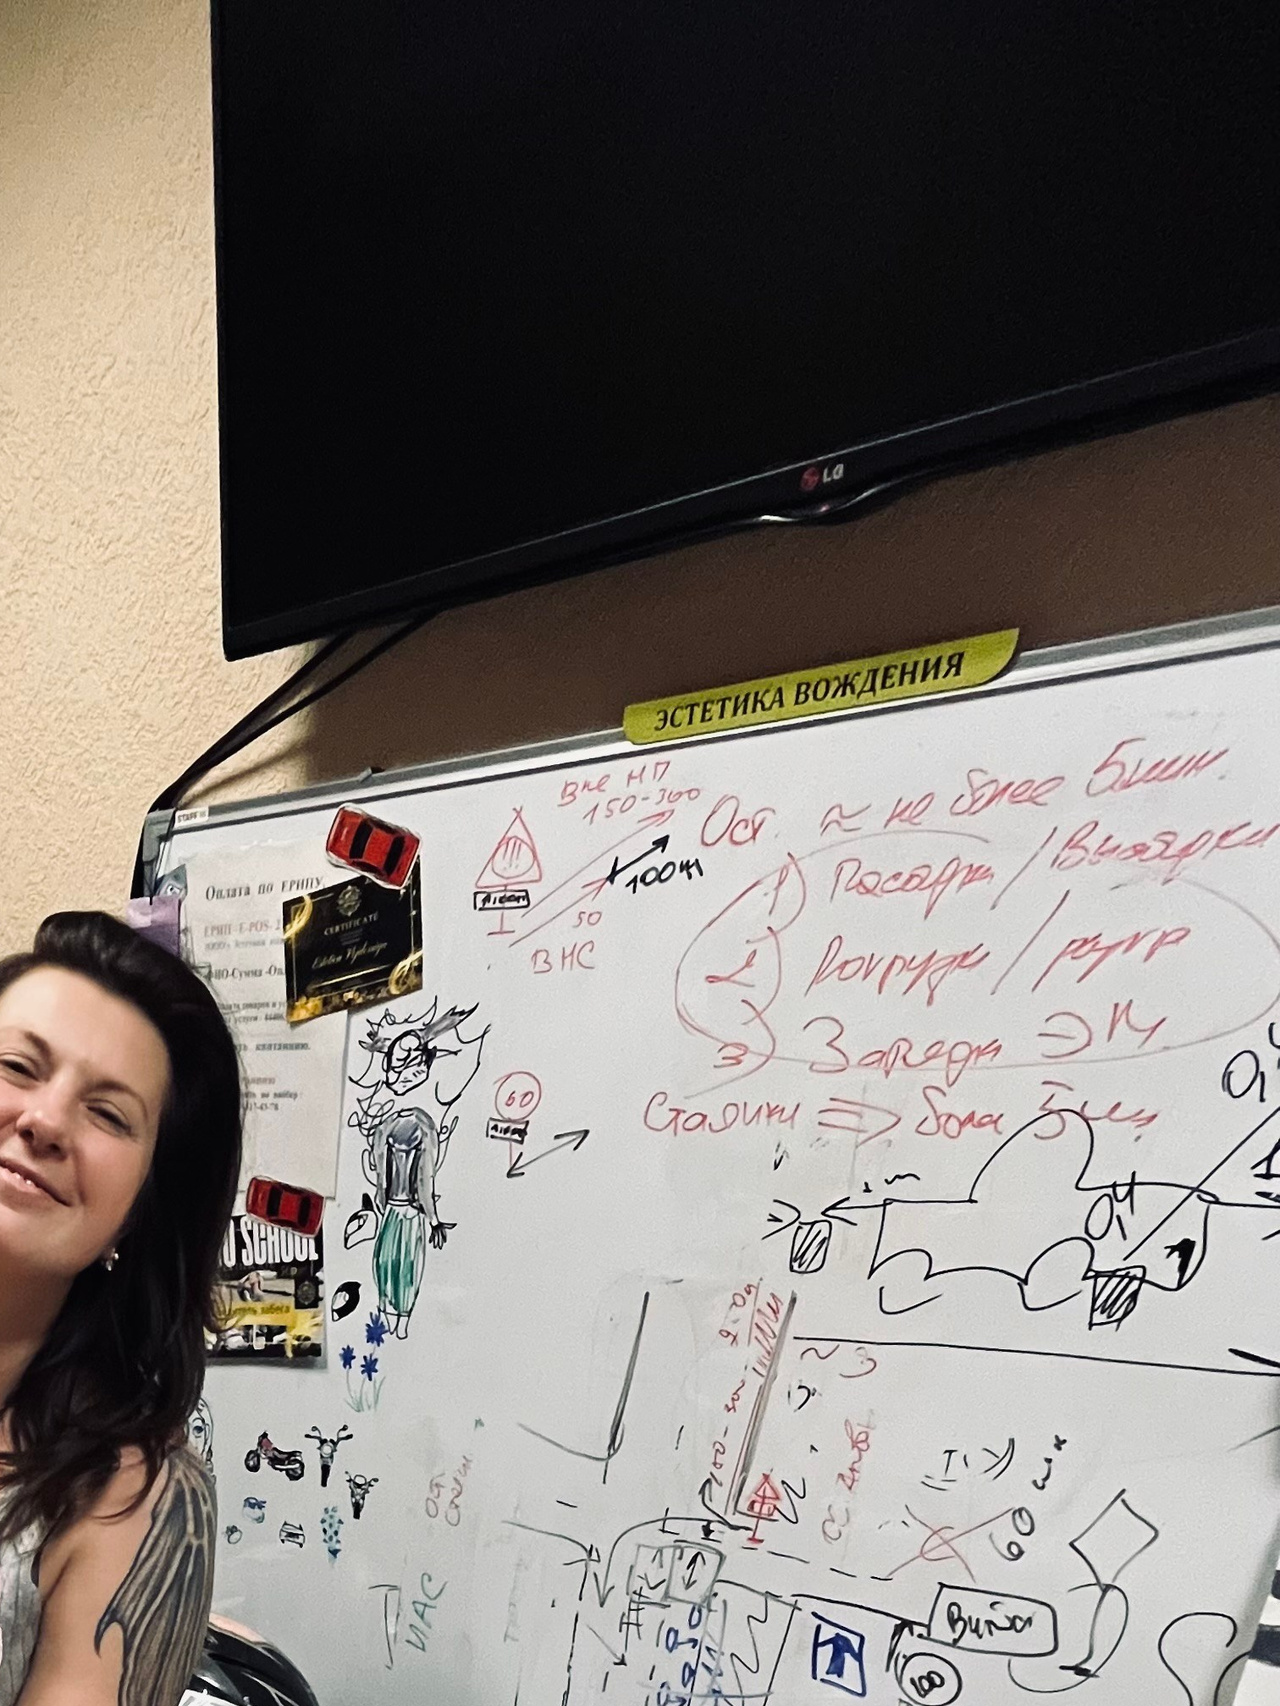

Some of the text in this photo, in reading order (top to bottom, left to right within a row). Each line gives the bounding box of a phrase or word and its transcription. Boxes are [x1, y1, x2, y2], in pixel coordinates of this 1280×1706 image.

[654, 651, 965, 732] ЭСТЕТИКА ВОЖДЕНИЯ
[557, 774, 611, 807] Вне
[205, 882, 251, 901] Оплата
[258, 882, 274, 895] по
[323, 911, 379, 936] CERTIFICATE
[573, 910, 602, 928] 50
[505, 1090, 534, 1108] 60
[239, 1216, 319, 1267] SCHOOL
